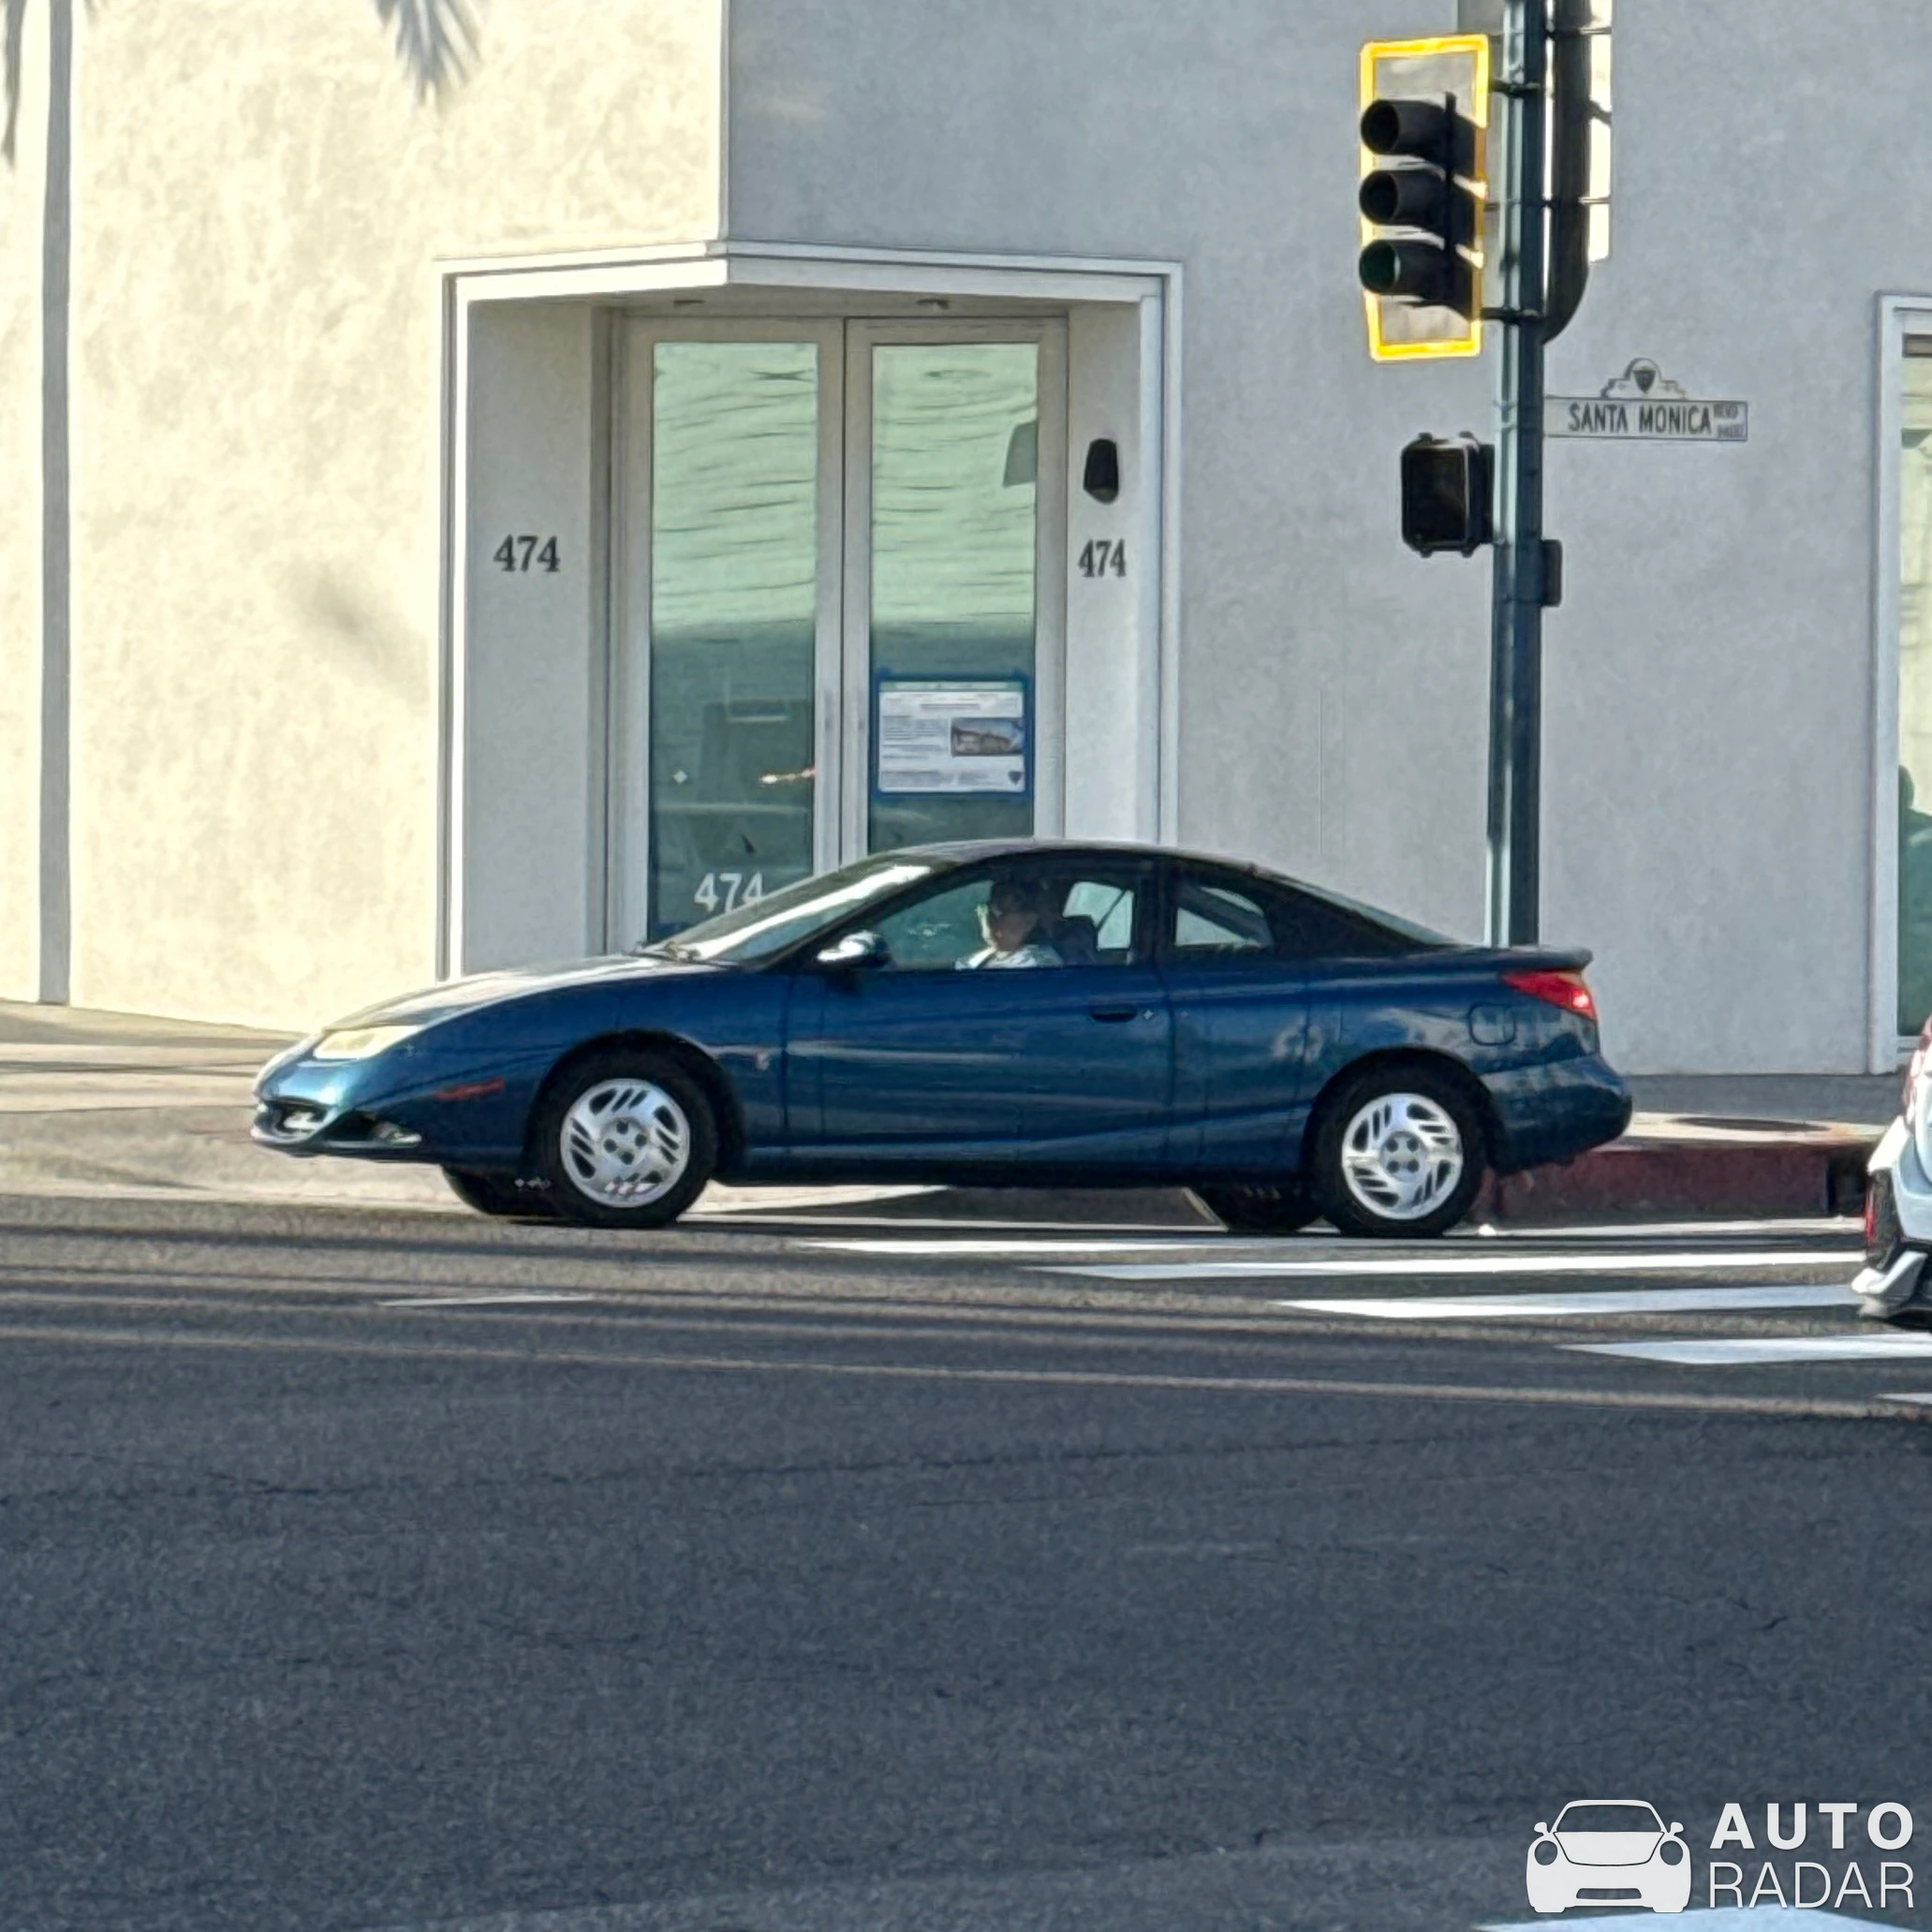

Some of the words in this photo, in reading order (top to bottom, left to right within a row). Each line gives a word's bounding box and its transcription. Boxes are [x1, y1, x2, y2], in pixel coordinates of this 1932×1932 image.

[1568, 402, 1628, 433] SANTA
[1639, 405, 1712, 435] MONICA
[493, 534, 561, 572] 474
[1078, 538, 1128, 578] 474
[694, 872, 763, 913] 474
